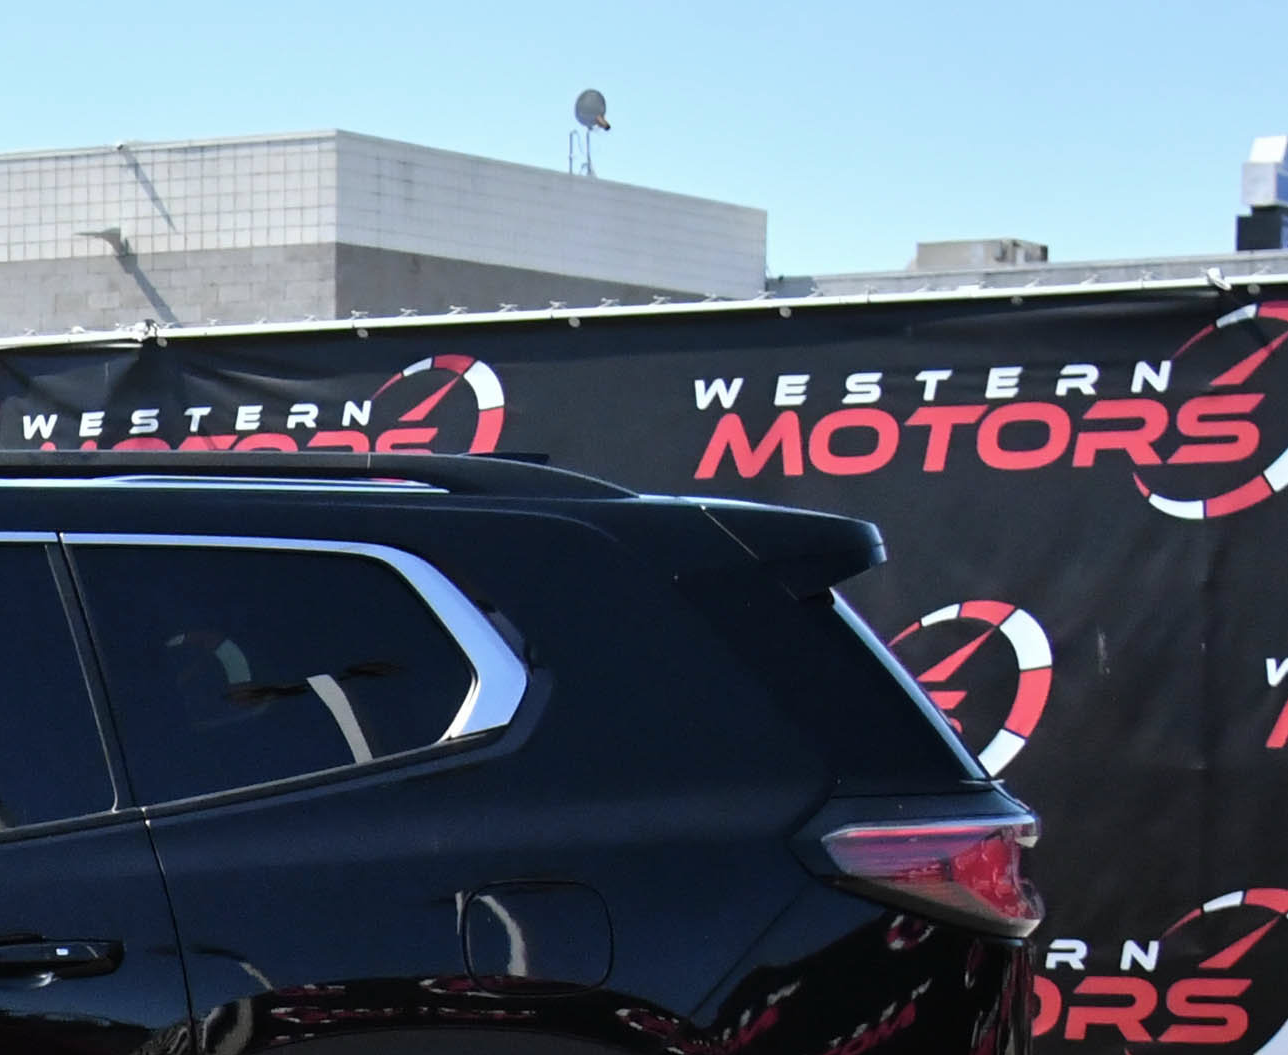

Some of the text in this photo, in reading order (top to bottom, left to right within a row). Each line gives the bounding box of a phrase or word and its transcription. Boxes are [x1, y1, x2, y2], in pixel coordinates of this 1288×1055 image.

[694, 360, 1173, 411] WESTERN
[22, 399, 373, 440] WESTERN
[694, 393, 1267, 480] MOTORS
